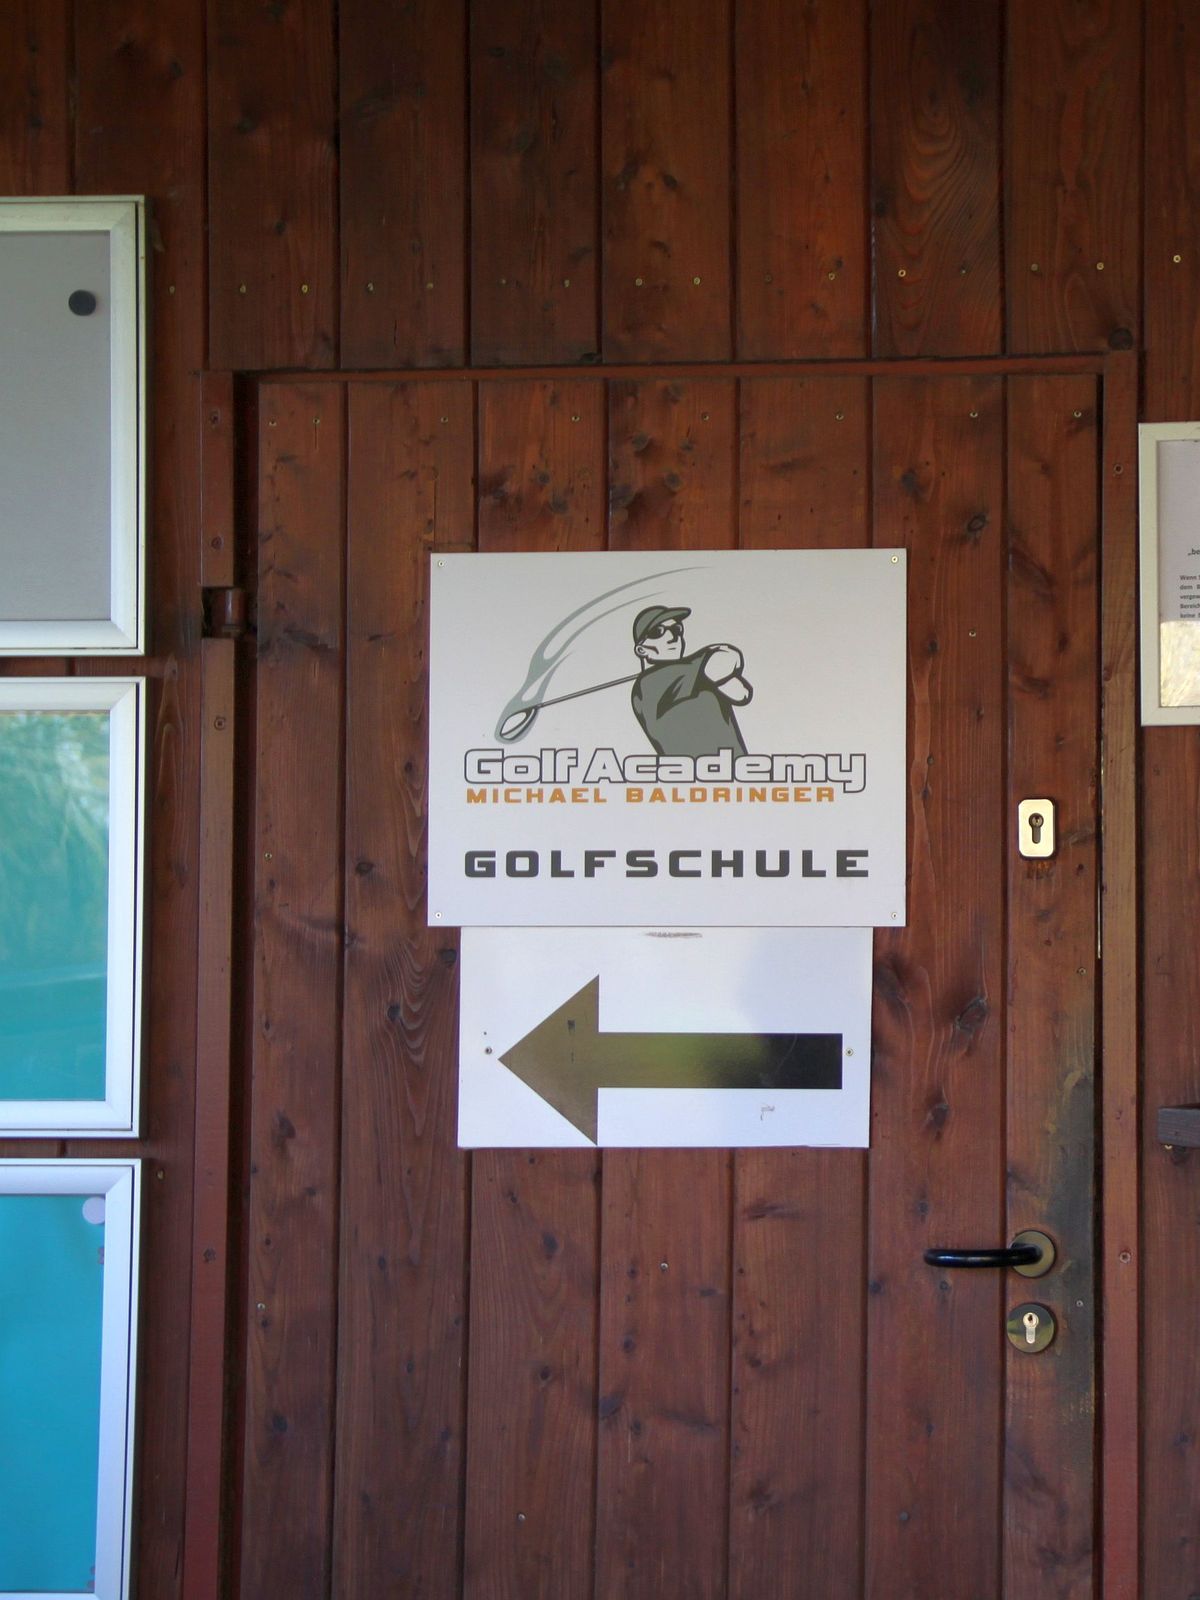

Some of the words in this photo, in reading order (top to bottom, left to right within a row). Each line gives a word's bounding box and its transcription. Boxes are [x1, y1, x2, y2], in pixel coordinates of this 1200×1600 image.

[464, 748, 579, 785] Golf
[582, 747, 867, 794] Academy
[466, 787, 607, 804] MICHAEL
[626, 786, 835, 804] BALDRINGER
[464, 849, 870, 879] GOLFSCHULE
